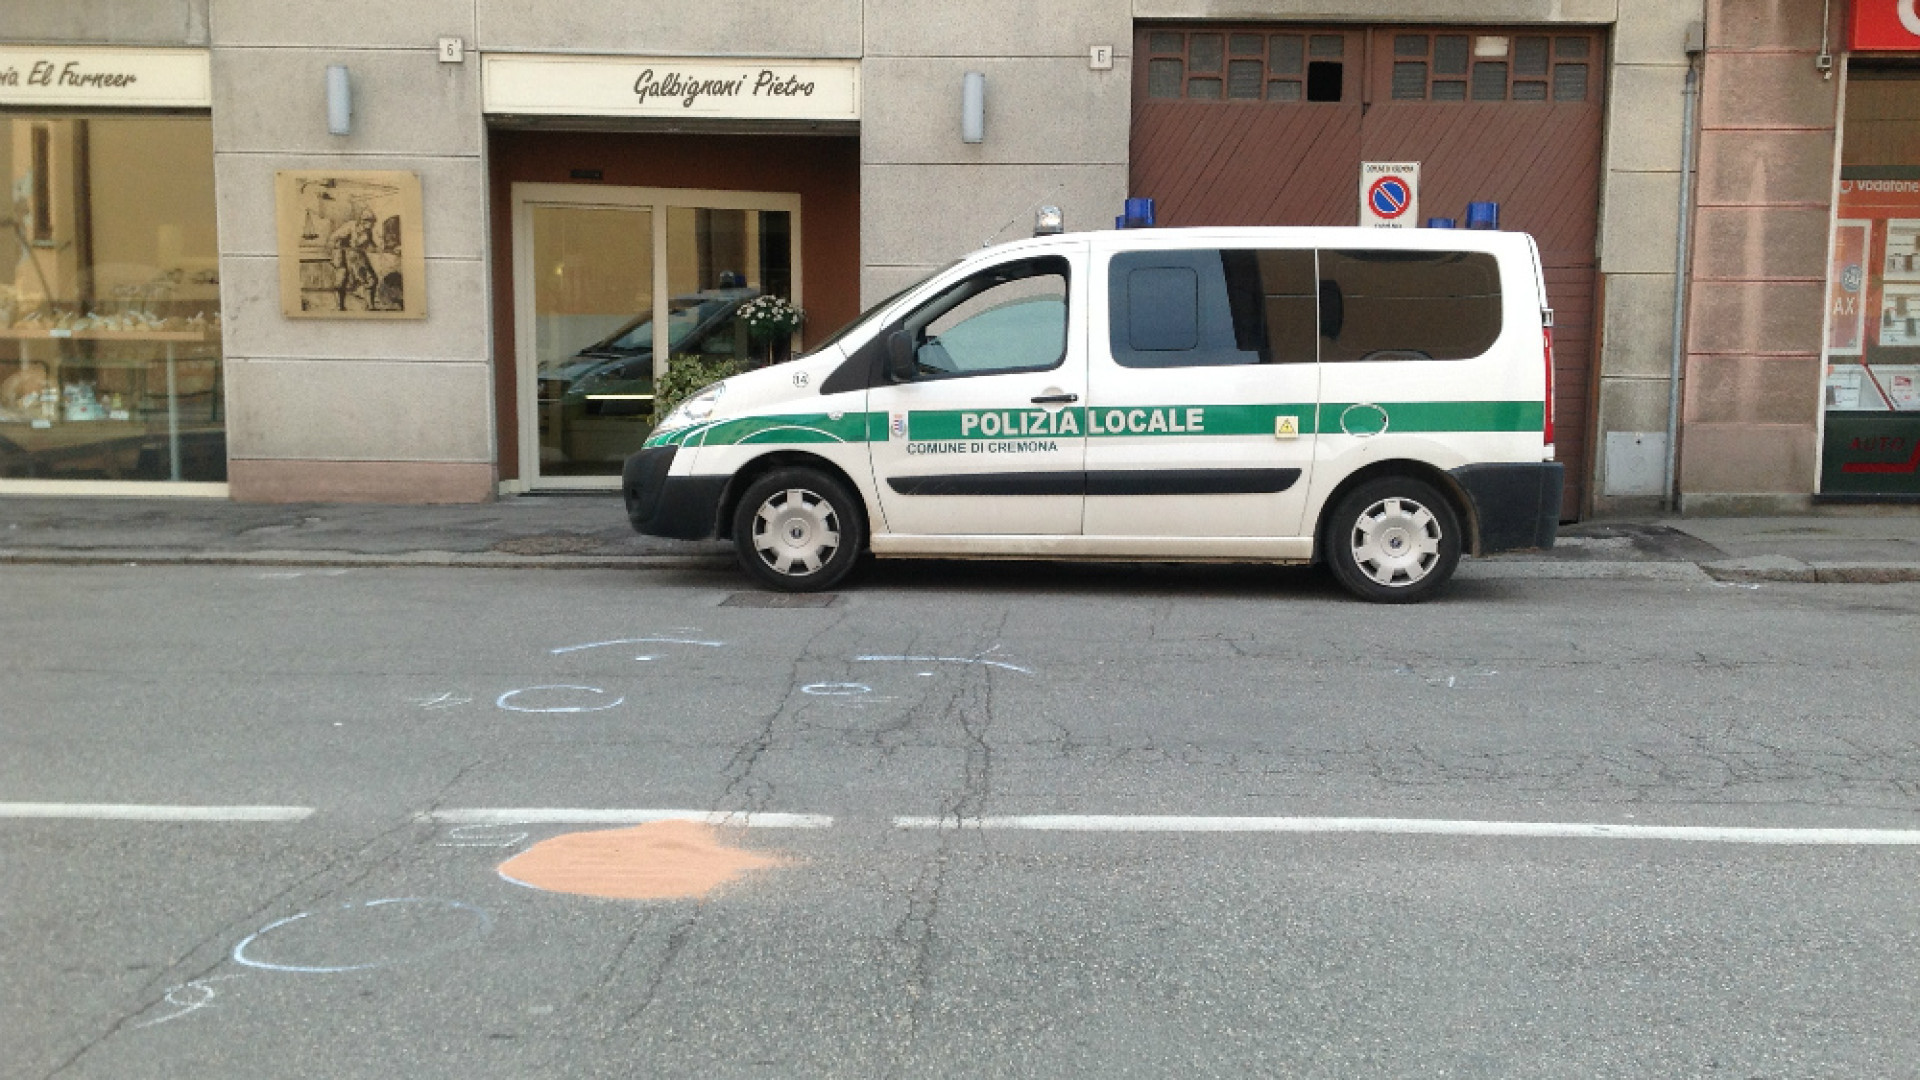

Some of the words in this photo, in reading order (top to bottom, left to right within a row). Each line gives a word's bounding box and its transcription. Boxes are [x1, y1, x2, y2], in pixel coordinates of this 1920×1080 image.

[447, 43, 454, 57] 6
[27, 60, 54, 87] El
[58, 61, 137, 88] Furneer
[752, 68, 815, 97] Pietro
[961, 410, 1080, 437] POLIZIA
[1088, 408, 1205, 434] LOCALE
[907, 441, 967, 455] COMUNE
[971, 441, 984, 454] DI
[988, 440, 1059, 454] CREMONA
